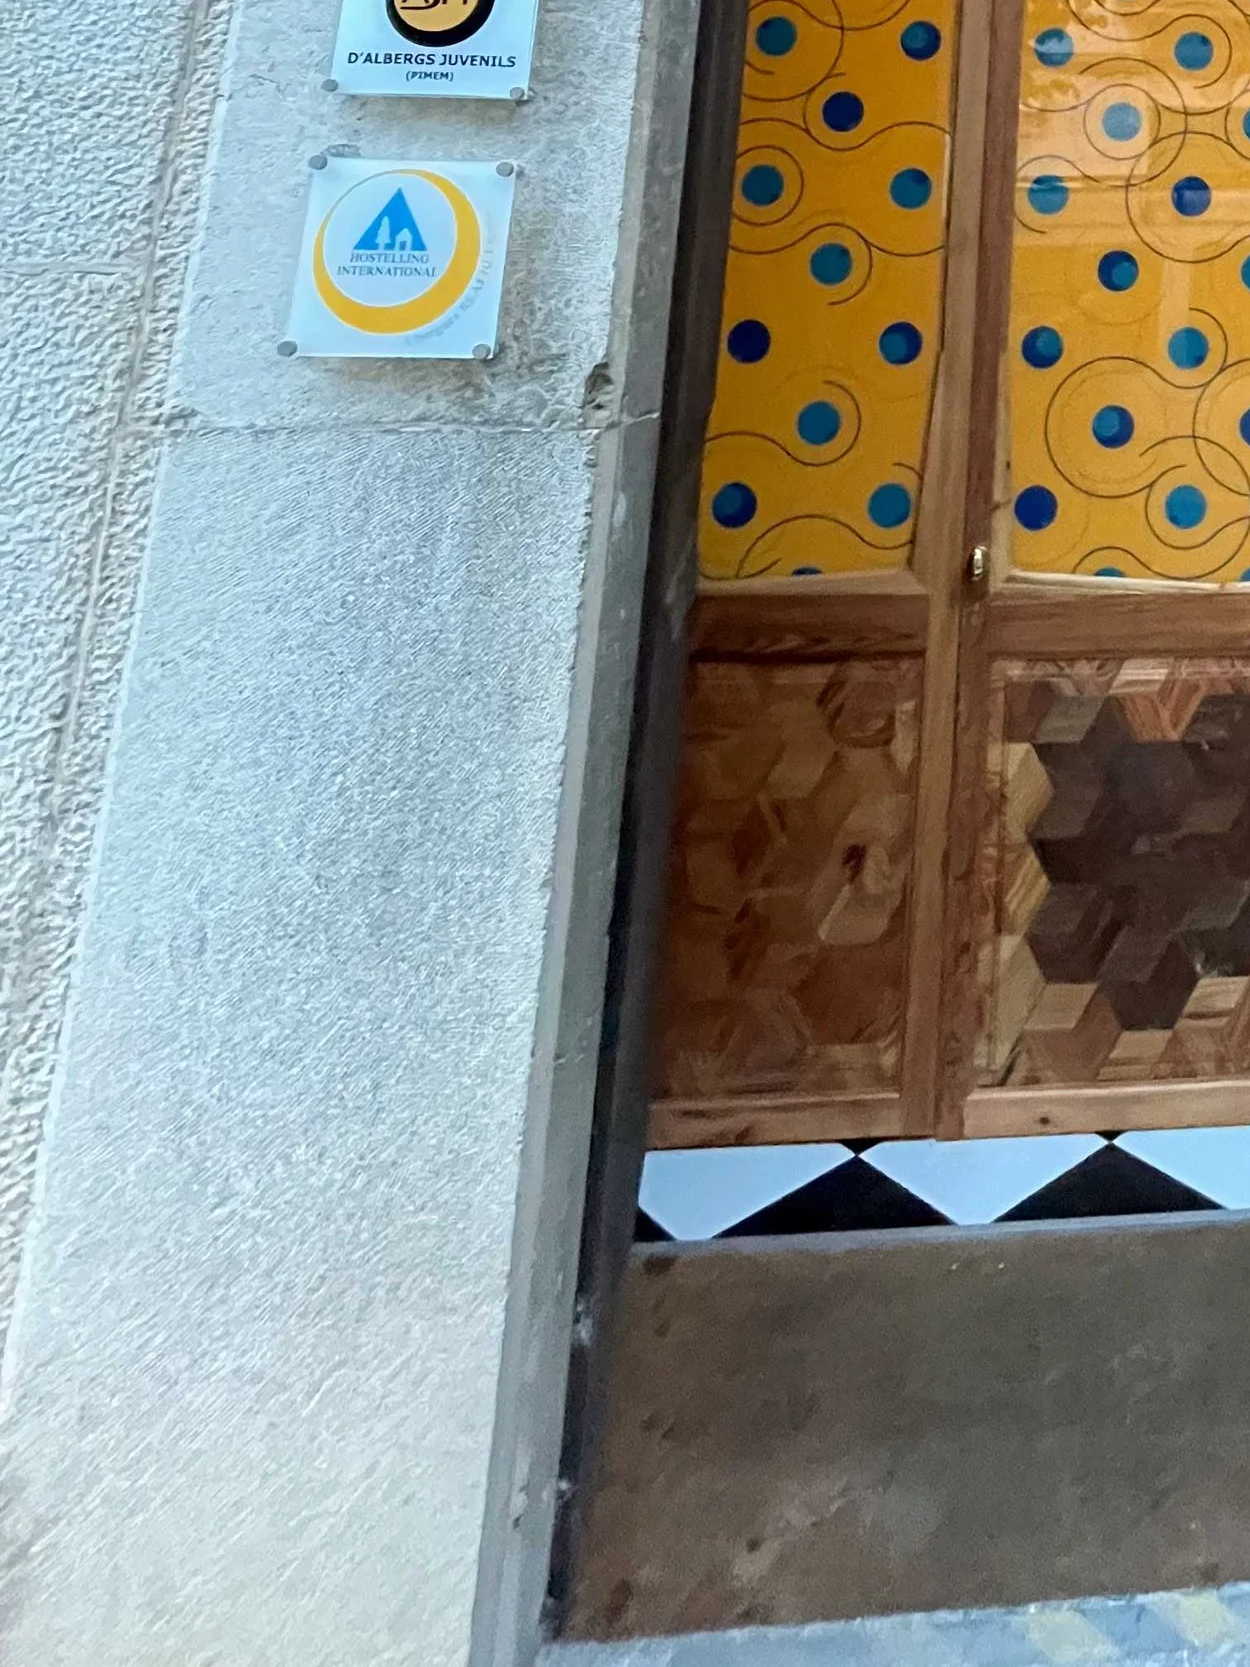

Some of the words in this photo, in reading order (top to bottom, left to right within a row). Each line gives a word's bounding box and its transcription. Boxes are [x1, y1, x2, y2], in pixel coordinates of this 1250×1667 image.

[347, 52, 436, 66] D'ALBERGS
[438, 53, 517, 68] JUVENILS
[405, 70, 454, 82] (PIMEM)
[350, 253, 430, 264] HOSTELLING
[337, 265, 436, 277] INTERNATIONAL
